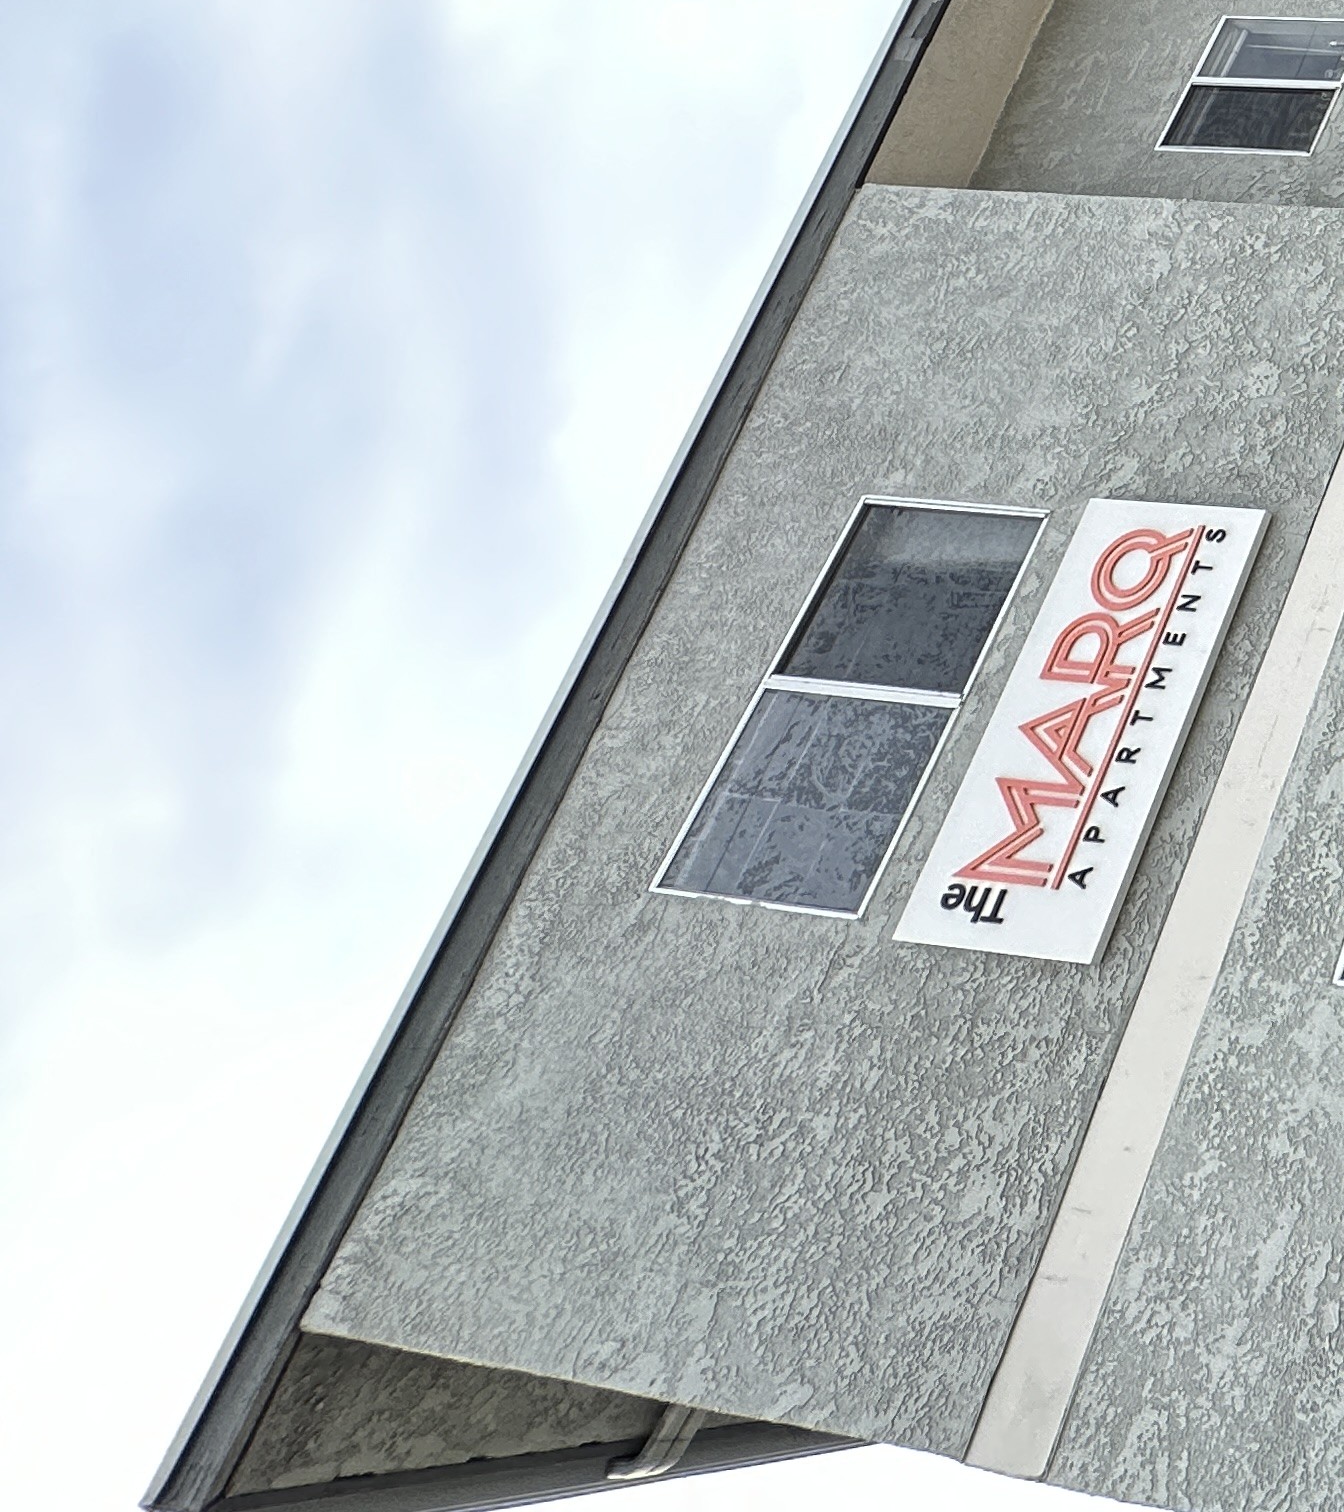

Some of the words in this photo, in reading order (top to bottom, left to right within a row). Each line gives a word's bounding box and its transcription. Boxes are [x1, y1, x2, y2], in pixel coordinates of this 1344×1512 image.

[950, 527, 1194, 887] MARQ
[1066, 527, 1227, 889] APARTMENTS
[938, 882, 1010, 924] The
